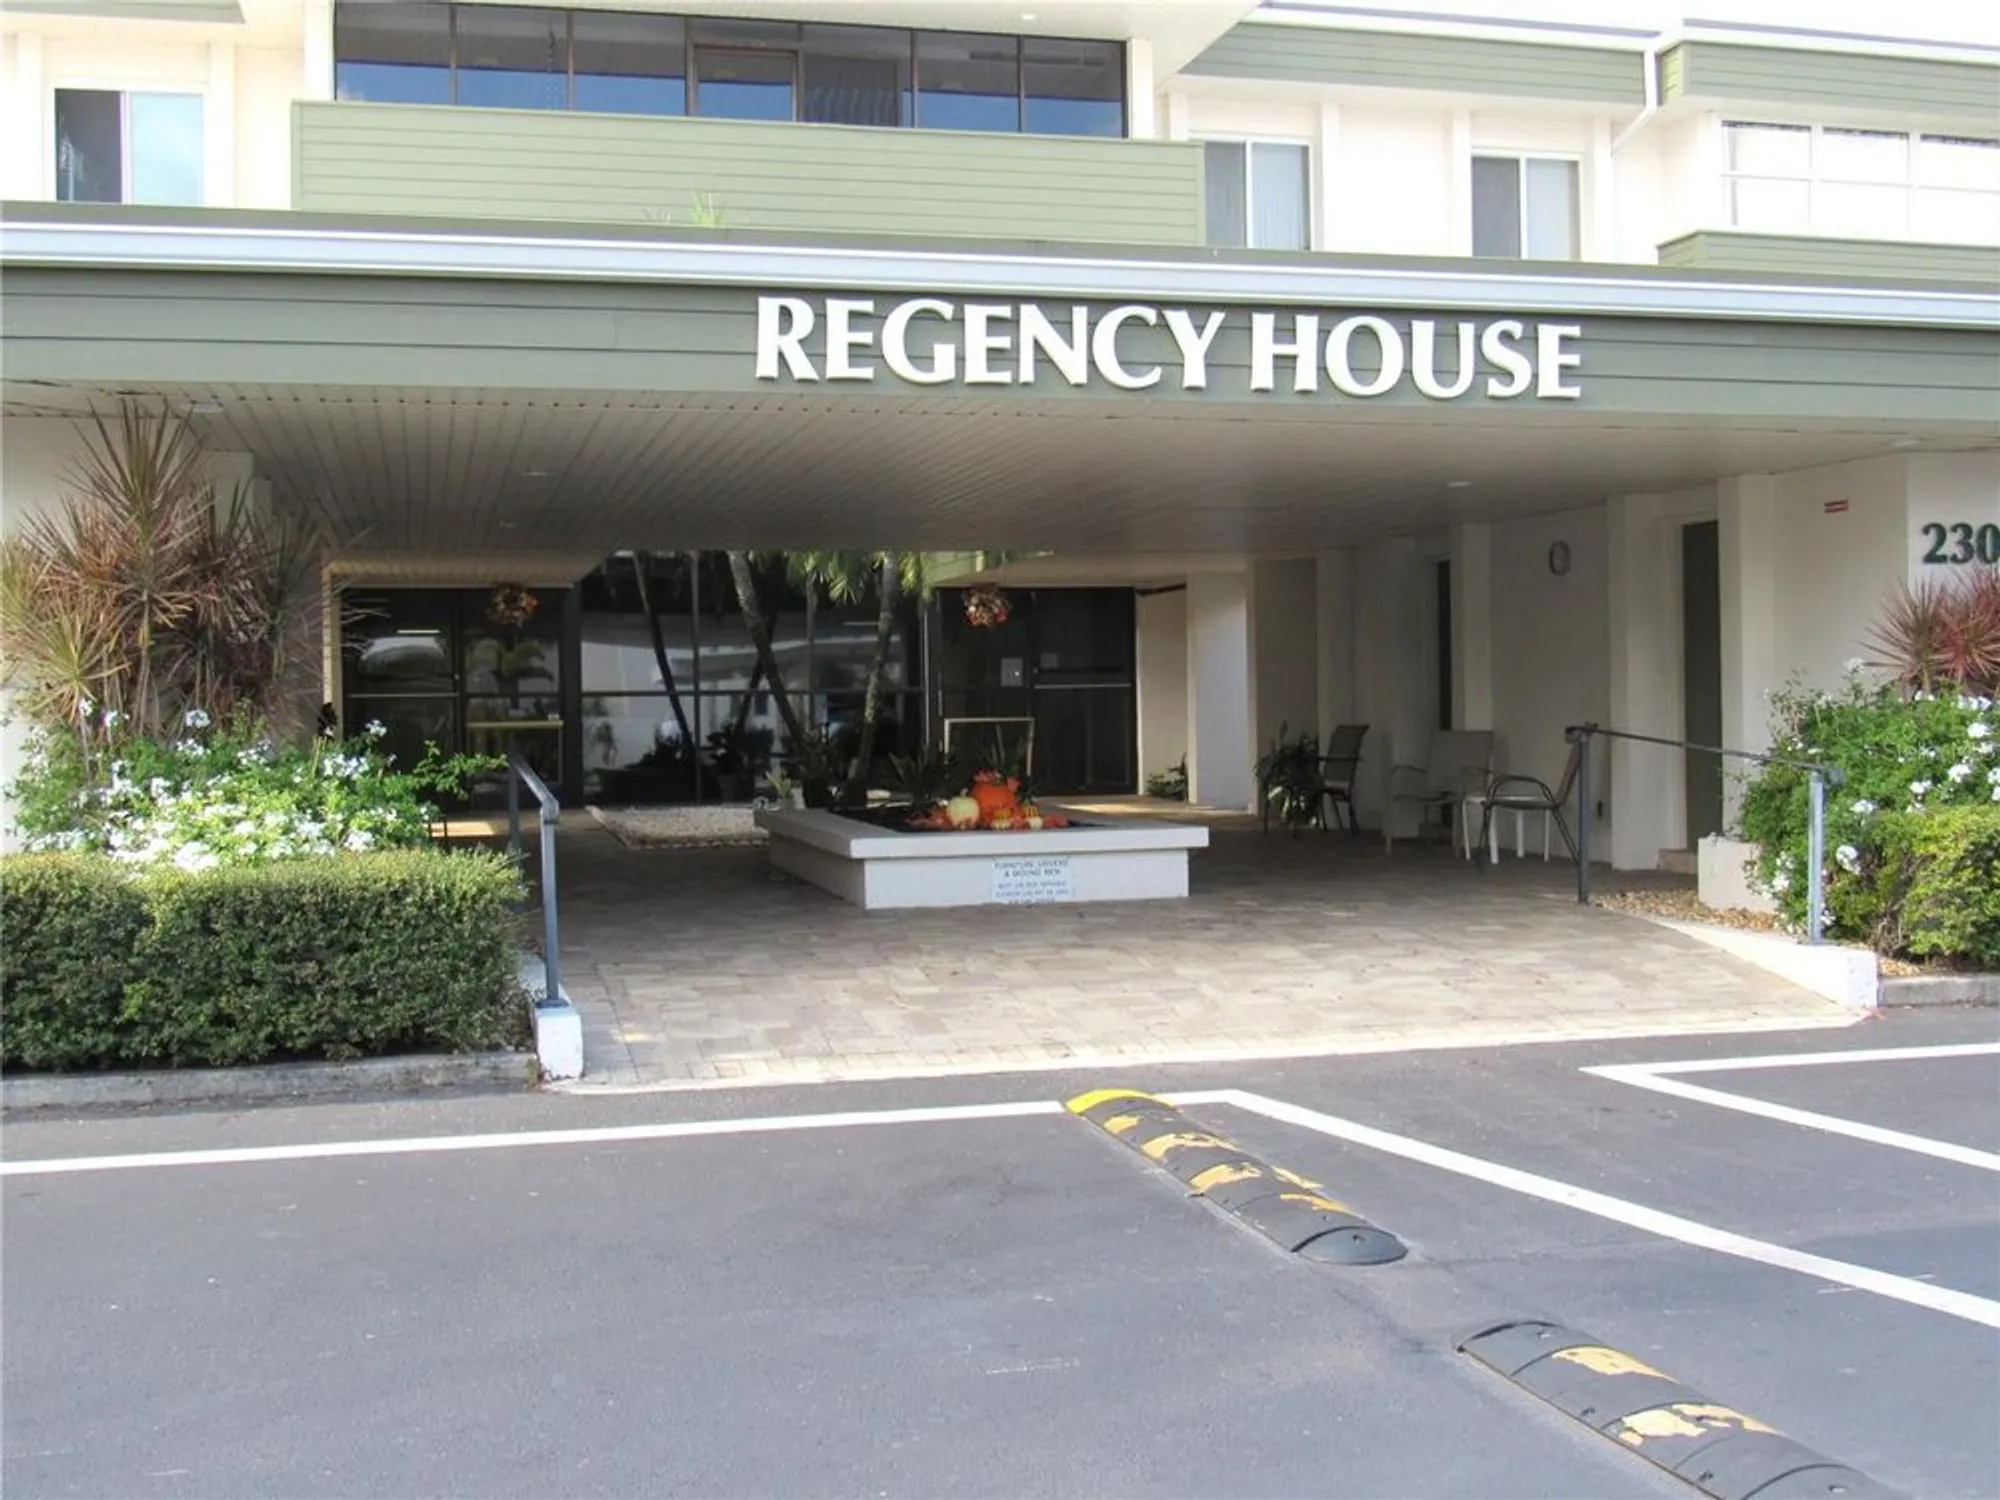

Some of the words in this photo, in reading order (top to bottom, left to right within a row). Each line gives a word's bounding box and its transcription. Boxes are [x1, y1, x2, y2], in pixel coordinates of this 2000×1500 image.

[755, 296, 1226, 389] REGENCY
[1250, 312, 1583, 400] HOUSE
[1922, 522, 2000, 565] 230
